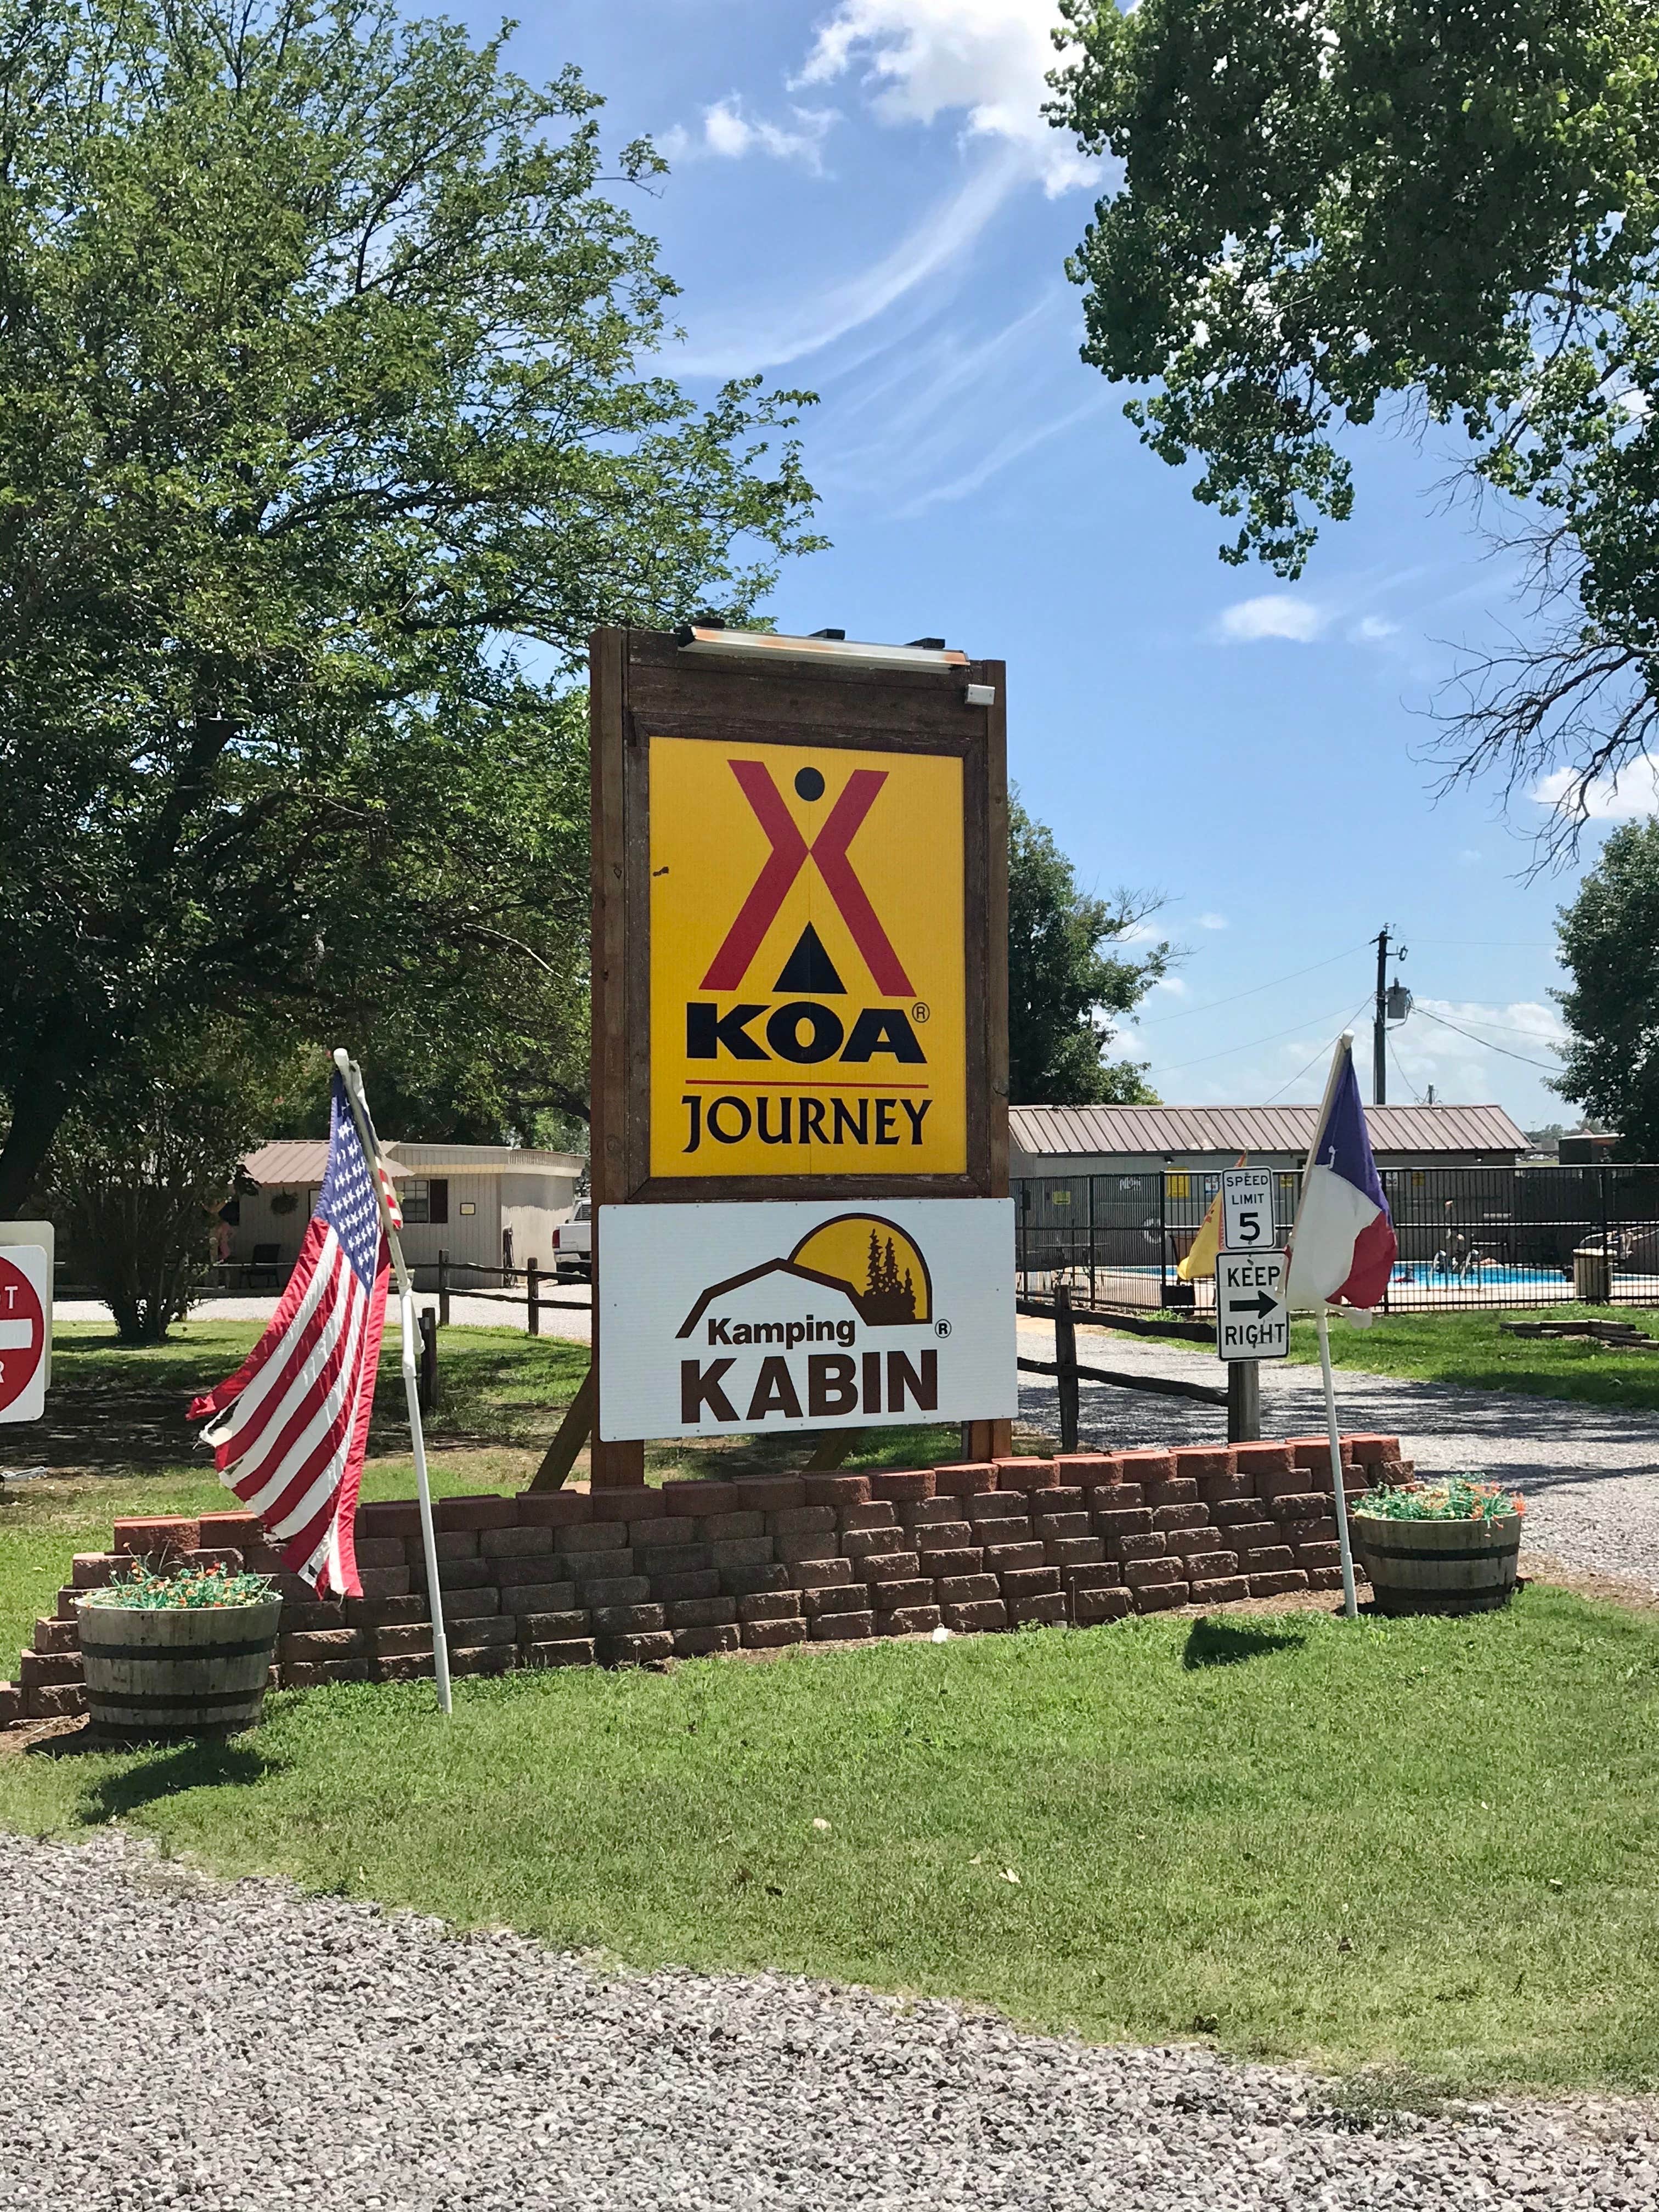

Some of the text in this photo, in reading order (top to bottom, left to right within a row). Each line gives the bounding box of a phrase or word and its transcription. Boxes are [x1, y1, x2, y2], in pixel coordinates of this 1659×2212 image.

[686, 1001, 928, 1064] KOA
[681, 1095, 933, 1153] JOURNEY
[1226, 1175, 1268, 1187] SPEED
[1232, 1193, 1264, 1205] LIMIT
[1239, 1212, 1260, 1240] 5
[1227, 1266, 1280, 1286] KEEP
[0, 1286, 18, 1309] T
[708, 1314, 855, 1350] Kamping
[1225, 1323, 1285, 1345] RIGHT
[681, 1349, 938, 1424] KABIN
